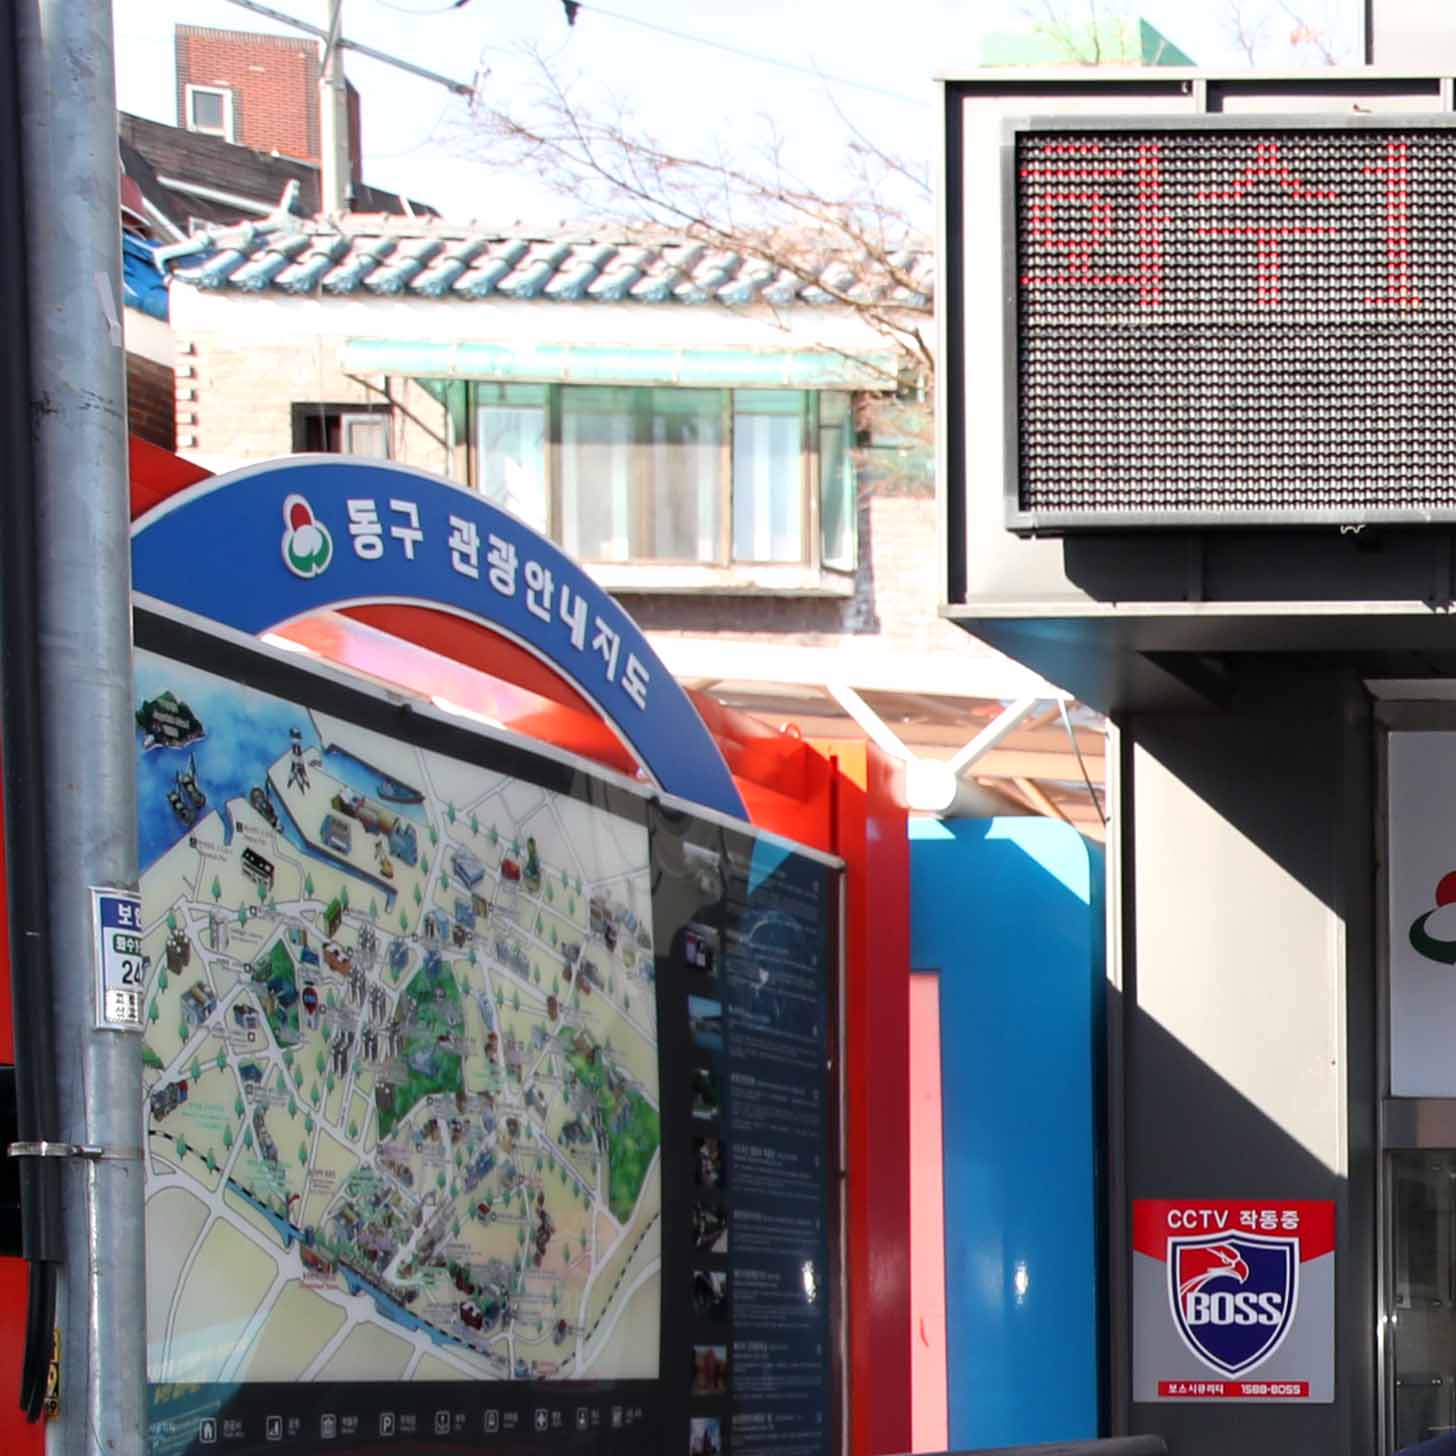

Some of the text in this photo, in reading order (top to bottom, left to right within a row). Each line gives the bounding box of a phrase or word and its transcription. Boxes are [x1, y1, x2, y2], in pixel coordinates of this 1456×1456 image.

[346, 498, 651, 711] 동구 관광안내지도
[1167, 1209, 1300, 1230] CCTV 작동중
[1185, 1292, 1283, 1325] BOSS
